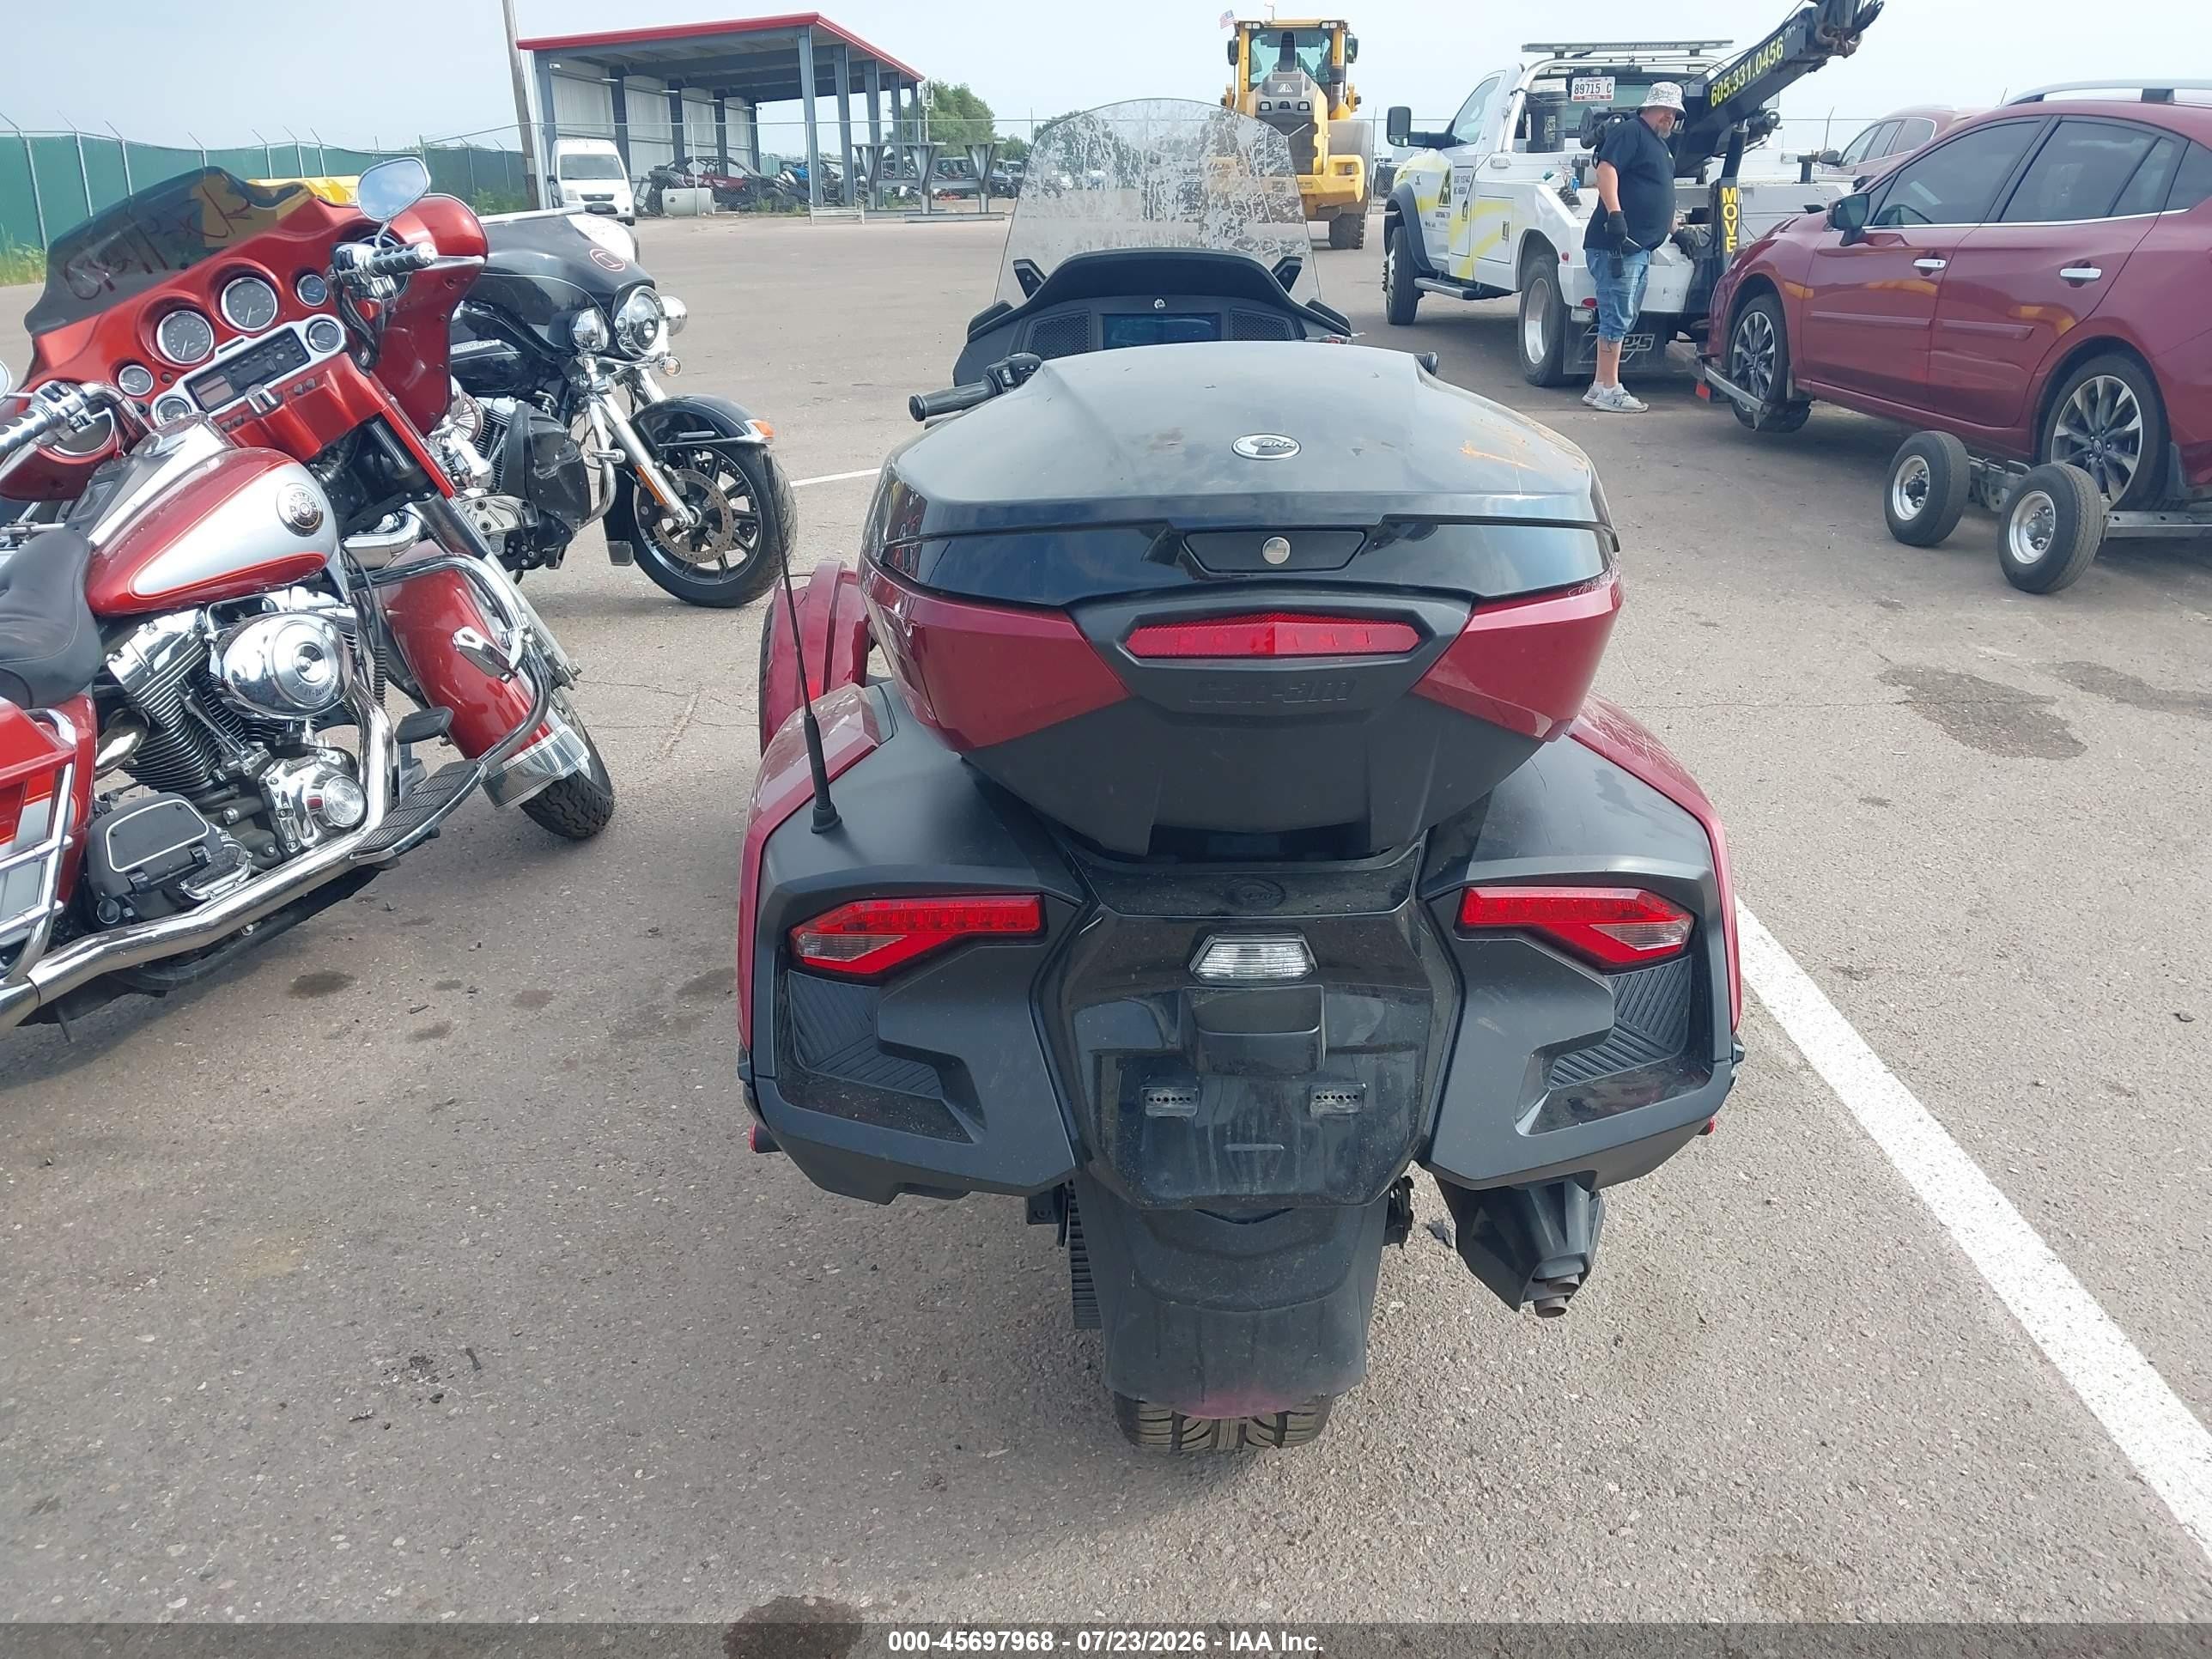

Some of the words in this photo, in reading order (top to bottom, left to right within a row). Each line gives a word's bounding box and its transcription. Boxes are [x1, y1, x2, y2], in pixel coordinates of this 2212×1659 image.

[1574, 83, 1601, 94] 89715
[1607, 82, 1613, 94] C
[1711, 36, 1784, 107] 605.331.0456
[1722, 187, 1738, 252] MOVE
